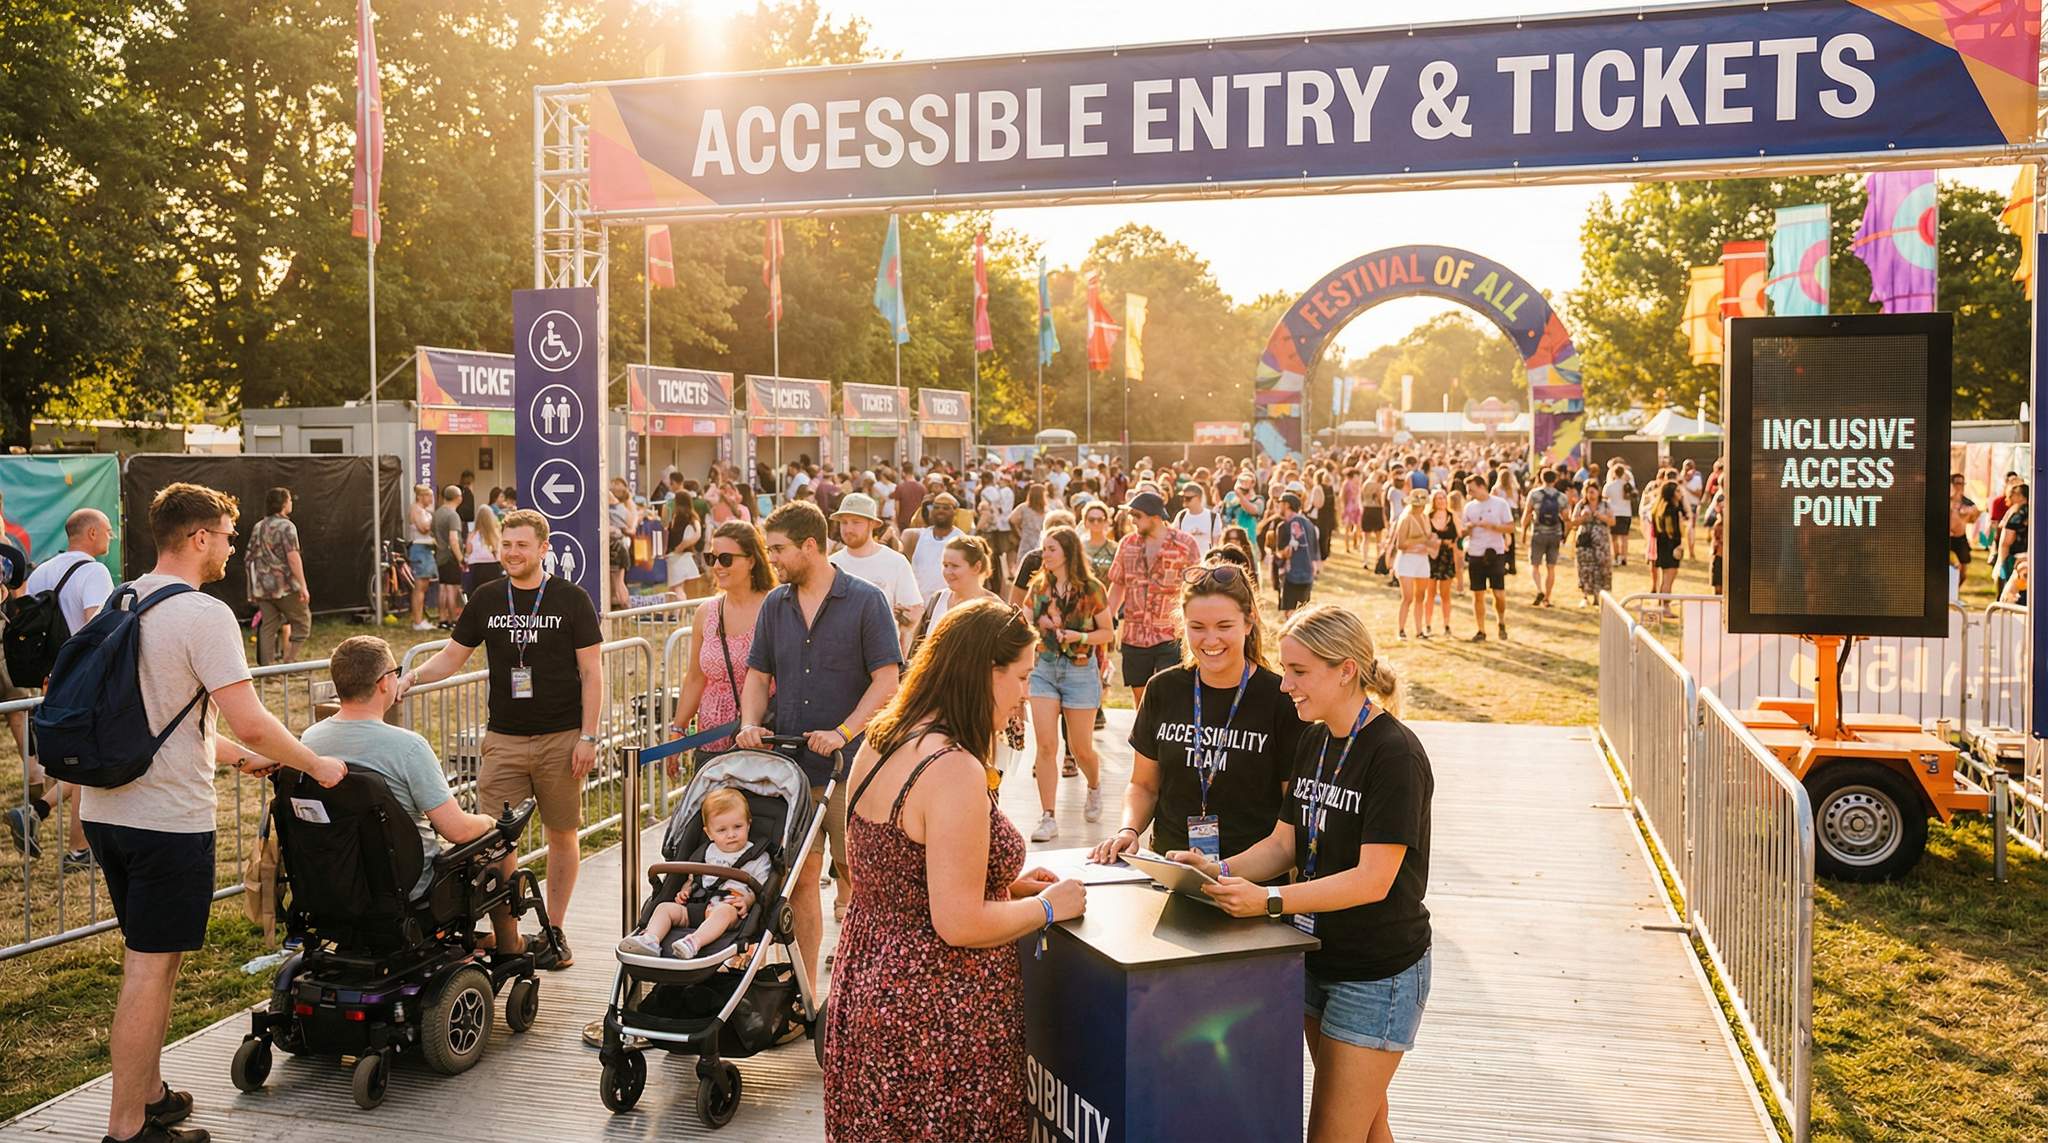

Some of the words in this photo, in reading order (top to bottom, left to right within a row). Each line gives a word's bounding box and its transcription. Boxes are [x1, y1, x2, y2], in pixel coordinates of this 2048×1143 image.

[691, 83, 1109, 178] ACCESSIBLE
[1132, 65, 1391, 154] ENTRY
[1410, 60, 1473, 140] &
[1497, 33, 1876, 134] TICKETS
[1299, 253, 1425, 331] FESTIVAL
[1433, 254, 1476, 289] OF
[1473, 271, 1530, 323] ALL
[658, 378, 709, 406] TICKETS
[771, 387, 811, 410] TICKETS
[861, 393, 893, 413] TICKETS
[932, 397, 958, 416] TICKETS
[1763, 418, 1915, 450] INCLUSIVE
[1781, 456, 1895, 489] ACCESS
[1793, 495, 1882, 528] POINT
[509, 630, 538, 643] TEAM
